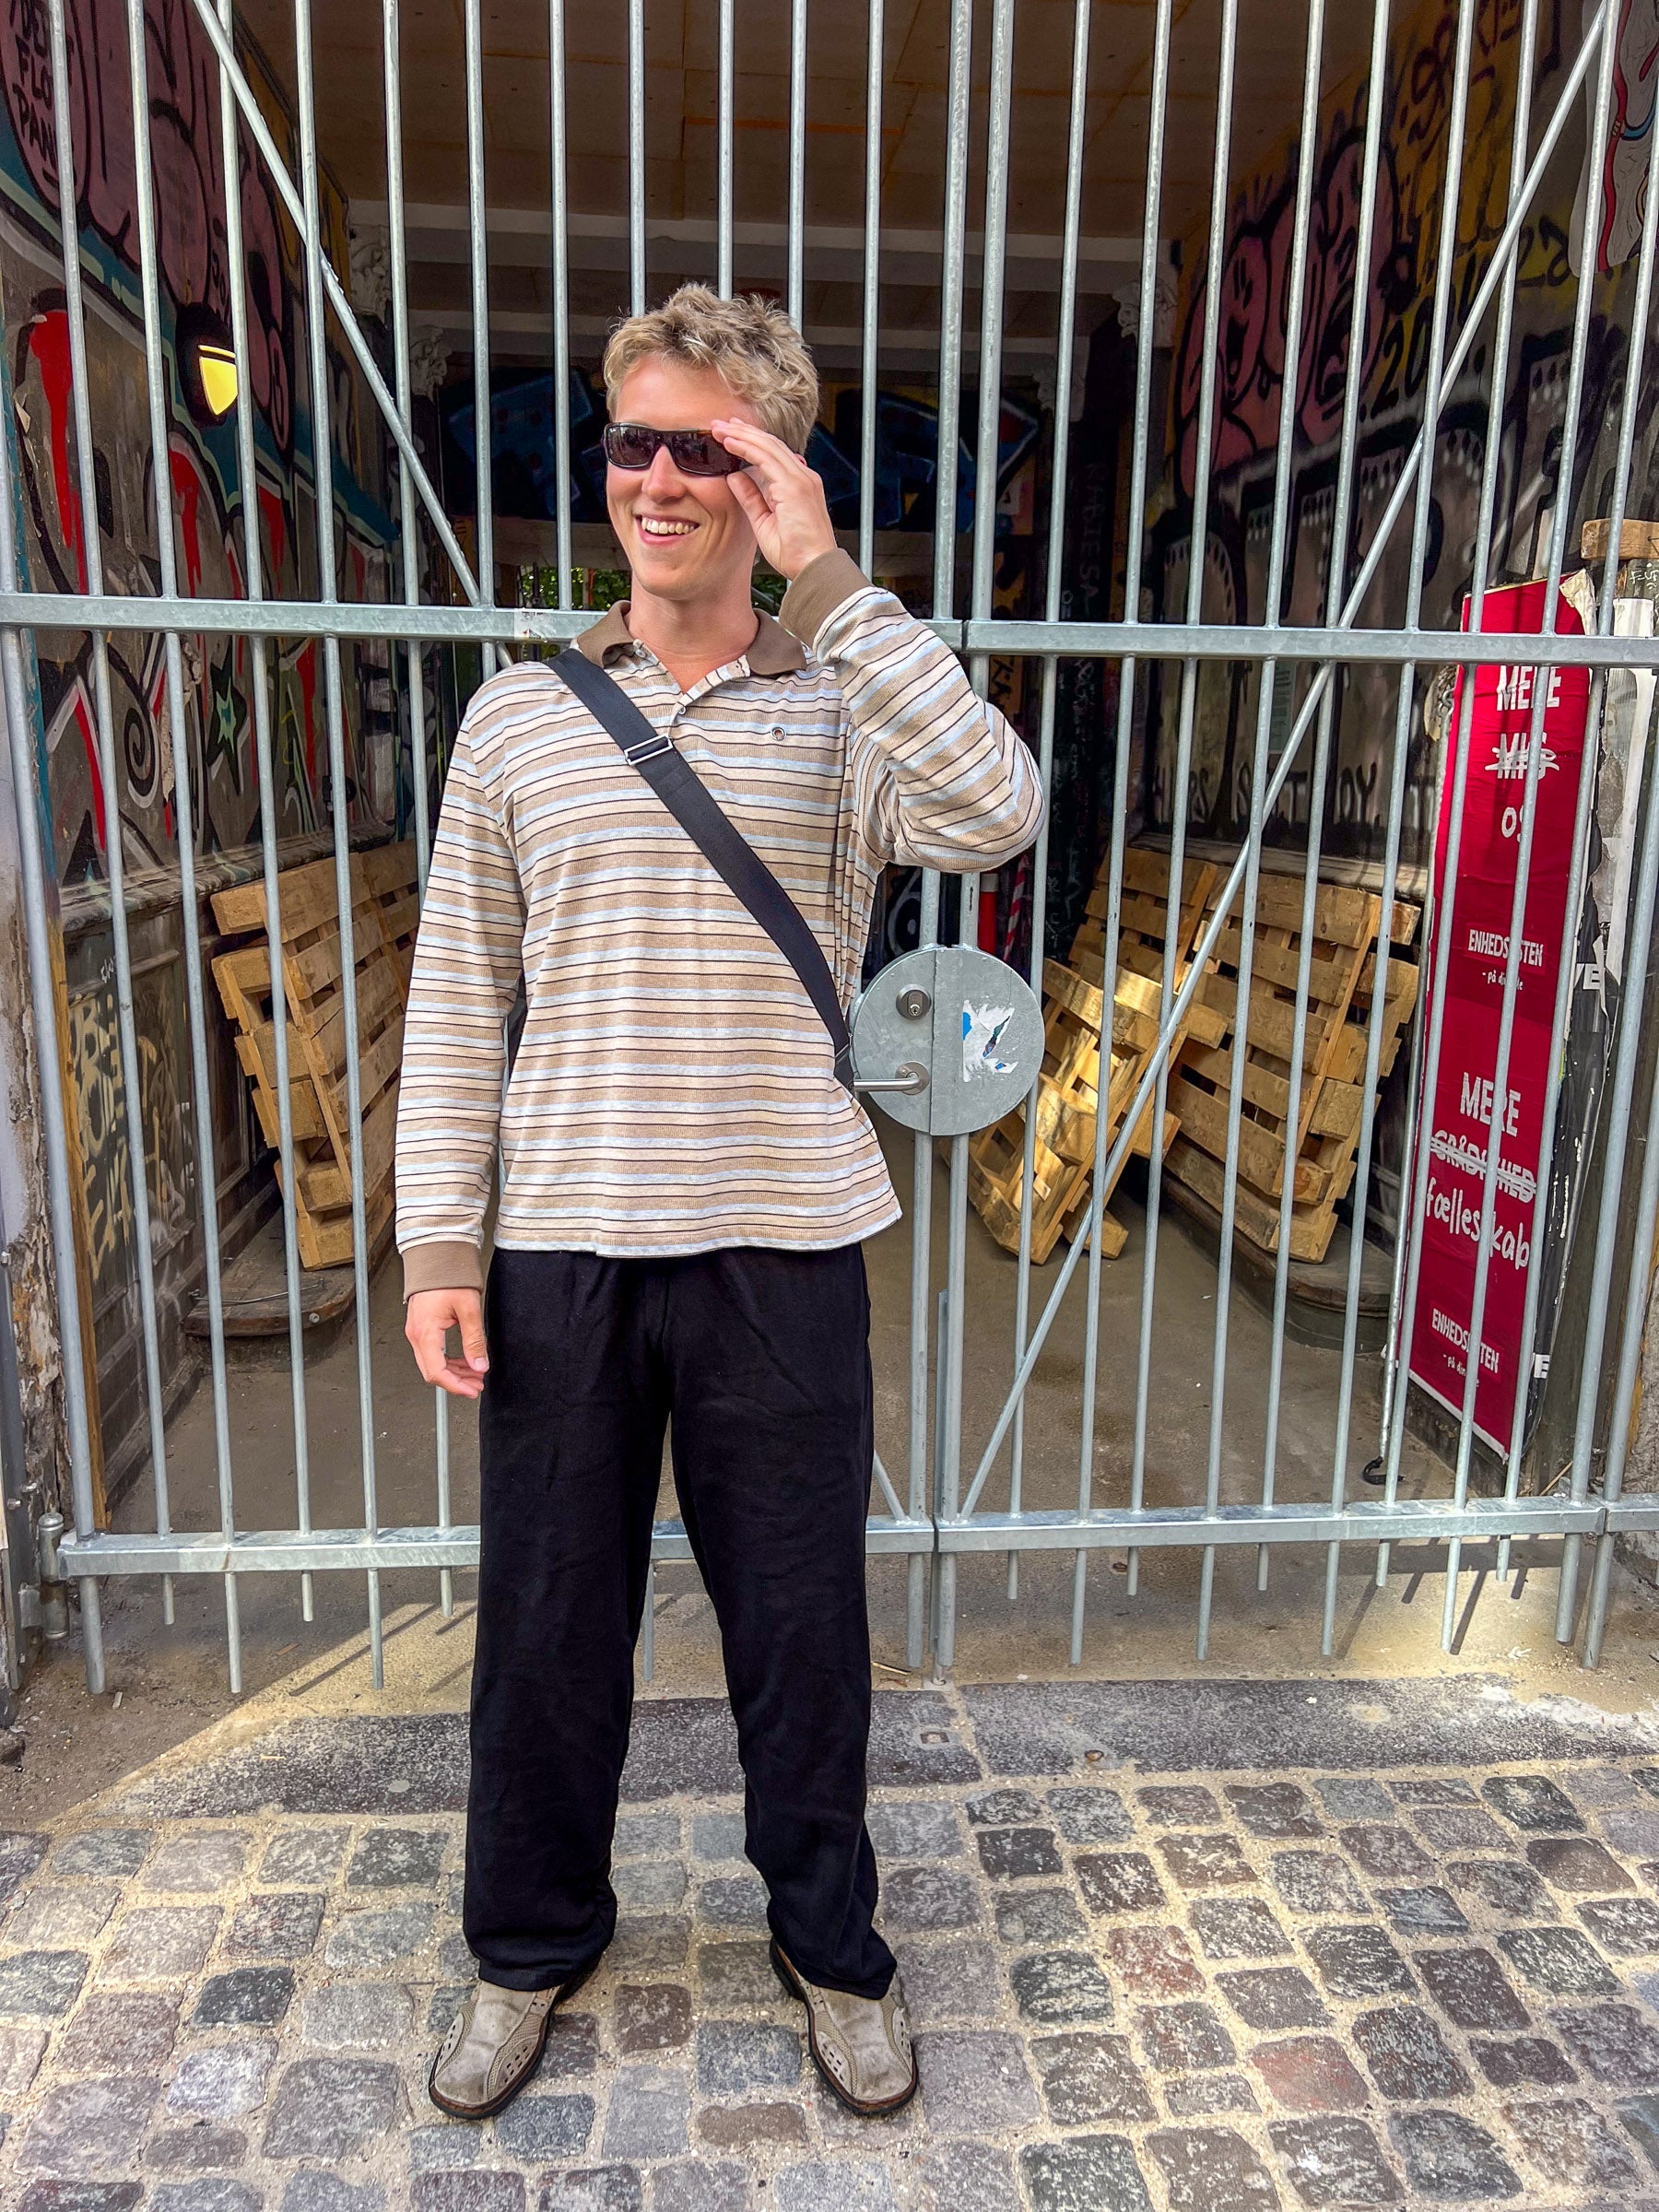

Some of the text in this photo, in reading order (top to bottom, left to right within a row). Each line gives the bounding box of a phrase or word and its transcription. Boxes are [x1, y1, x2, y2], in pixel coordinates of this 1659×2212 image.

[1497, 665, 1561, 712] MEE
[1467, 929, 1544, 968] ENHEDSTEN
[1432, 1130, 1535, 1204] GRÅDIHED
[1426, 1177, 1530, 1270] fælleskab
[1431, 1308, 1500, 1374] ENHEDSTEN
